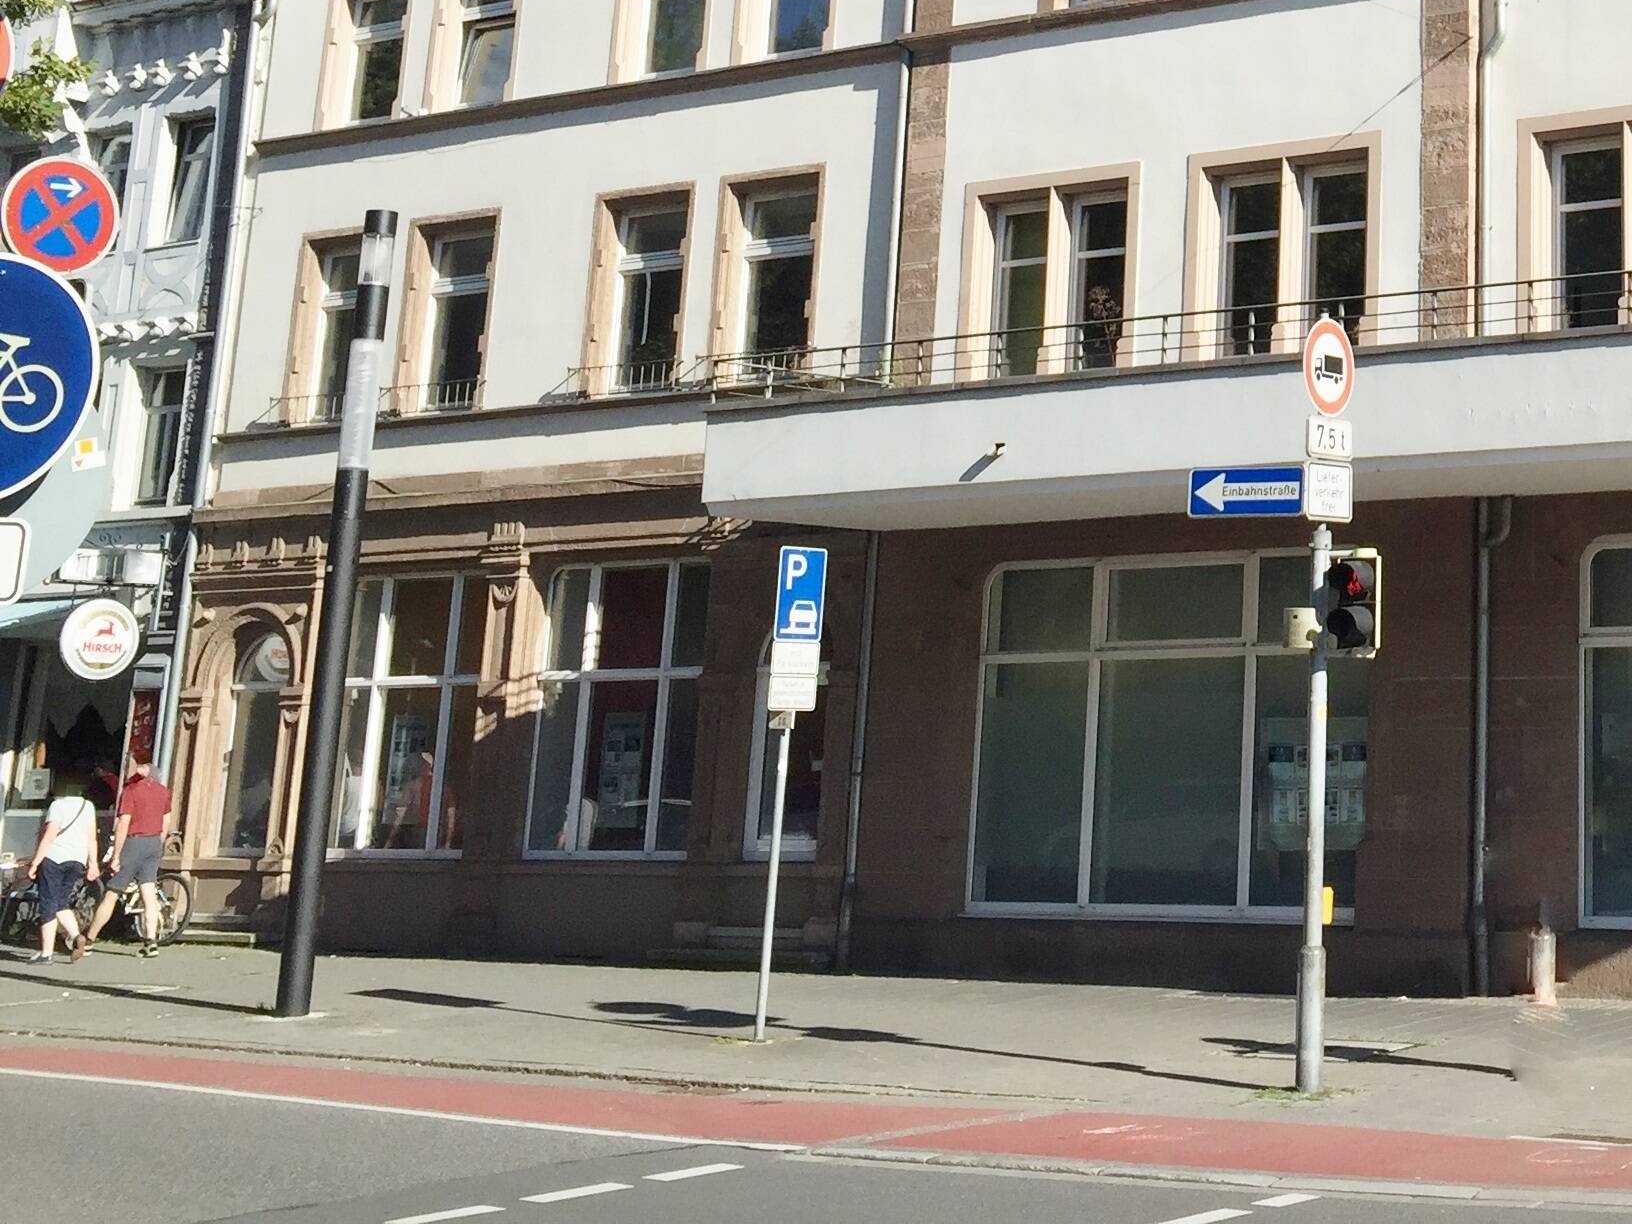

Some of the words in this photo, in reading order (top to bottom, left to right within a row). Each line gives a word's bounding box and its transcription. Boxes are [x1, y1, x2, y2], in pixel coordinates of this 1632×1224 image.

[1316, 424, 1336, 450] 7,5
[1222, 485, 1297, 497] Einbahnstraße
[786, 554, 808, 590] P
[82, 641, 123, 654] HIRSCH
